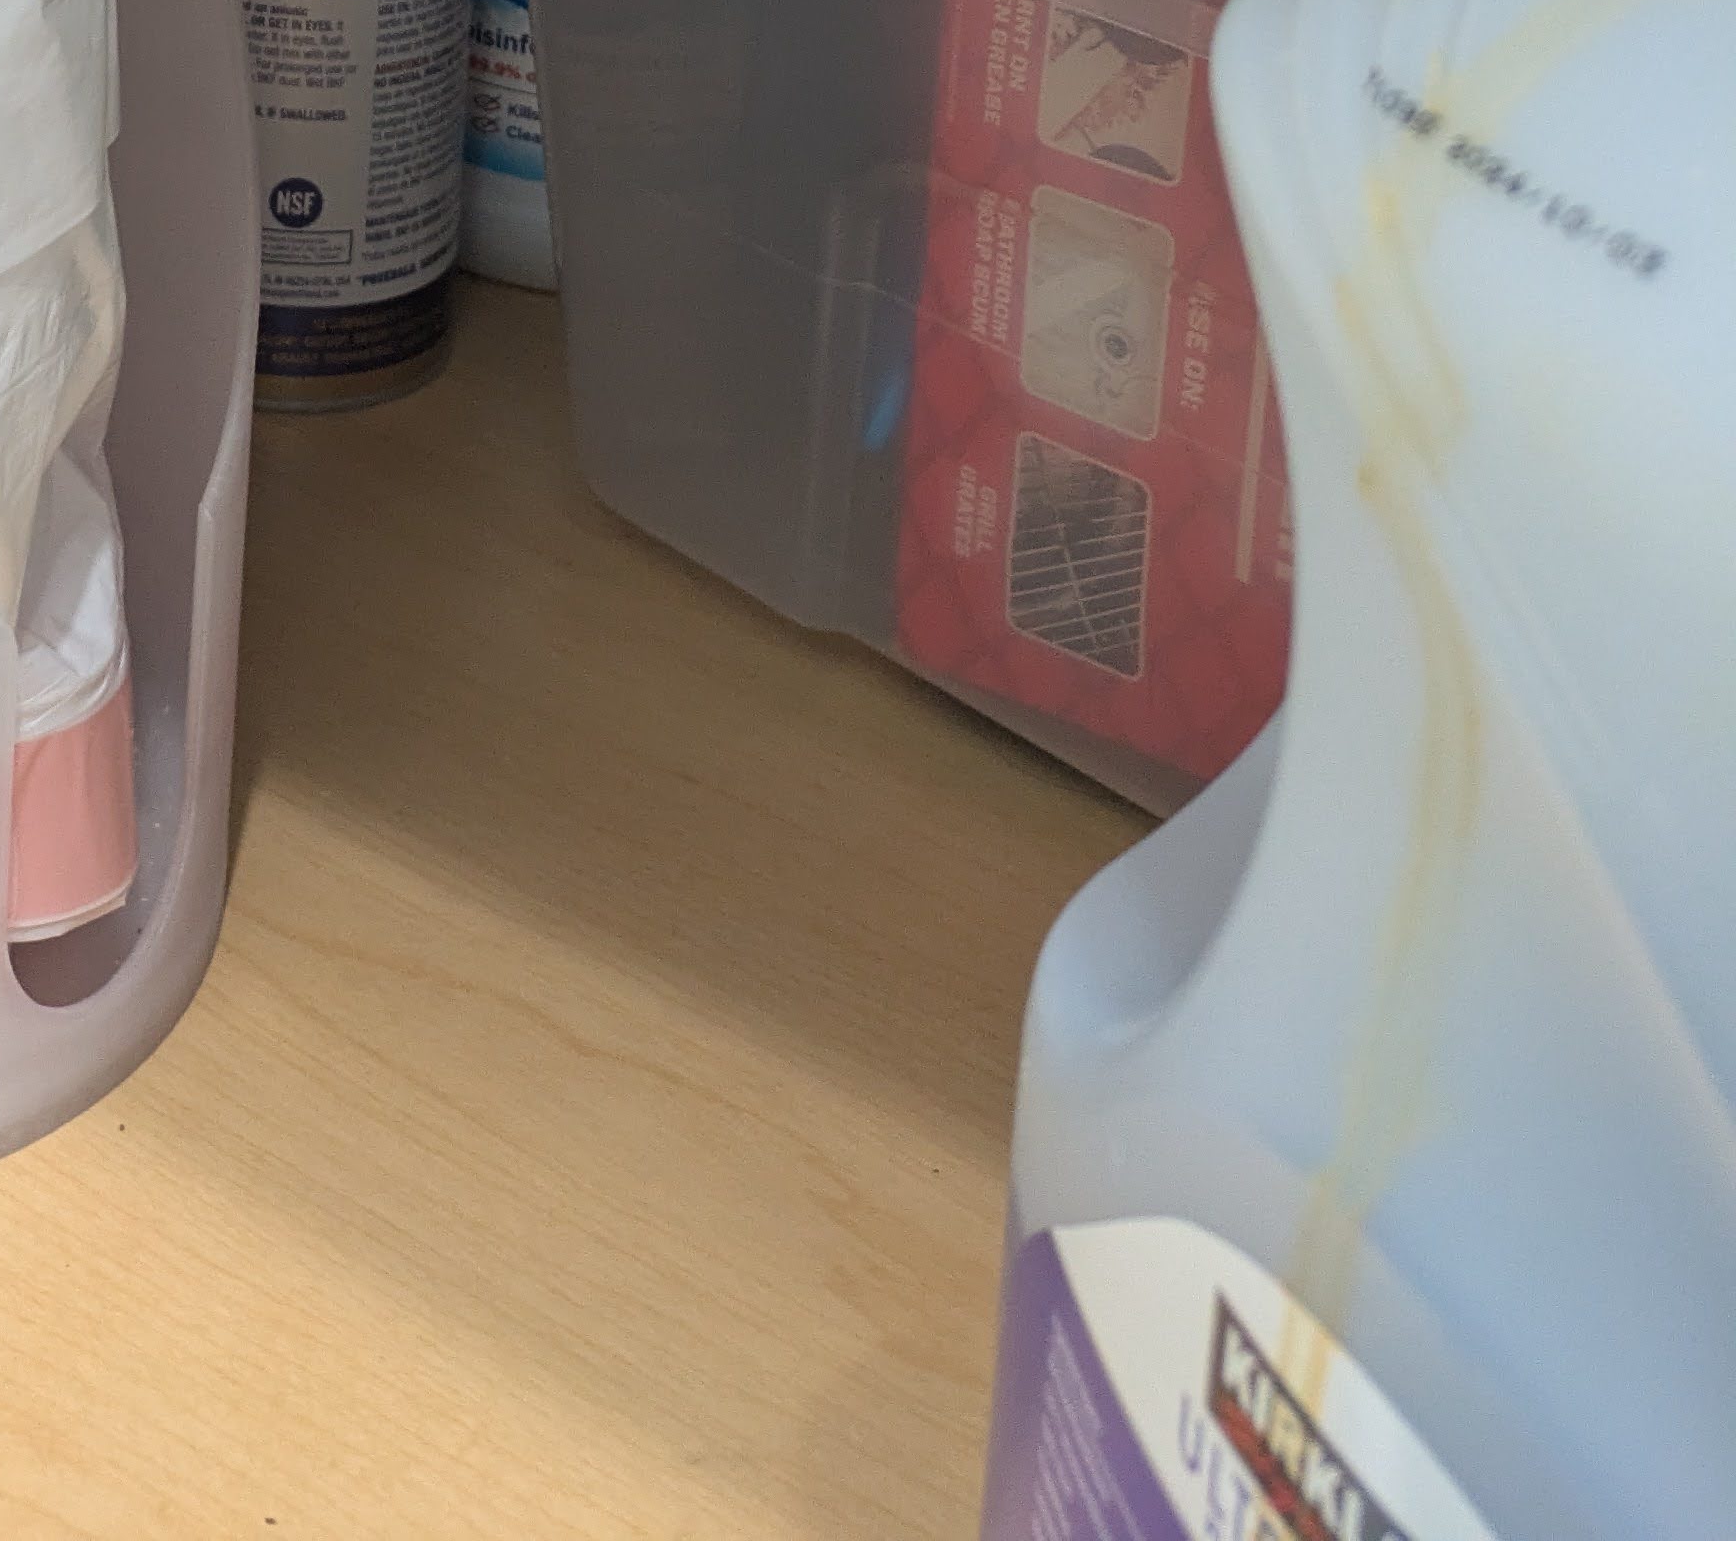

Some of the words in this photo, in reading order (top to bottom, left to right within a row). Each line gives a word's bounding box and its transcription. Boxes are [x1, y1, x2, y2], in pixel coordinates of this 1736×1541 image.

[268, 16, 288, 29] GET
[984, 28, 1008, 126] GREASE
[276, 190, 316, 216] NSF
